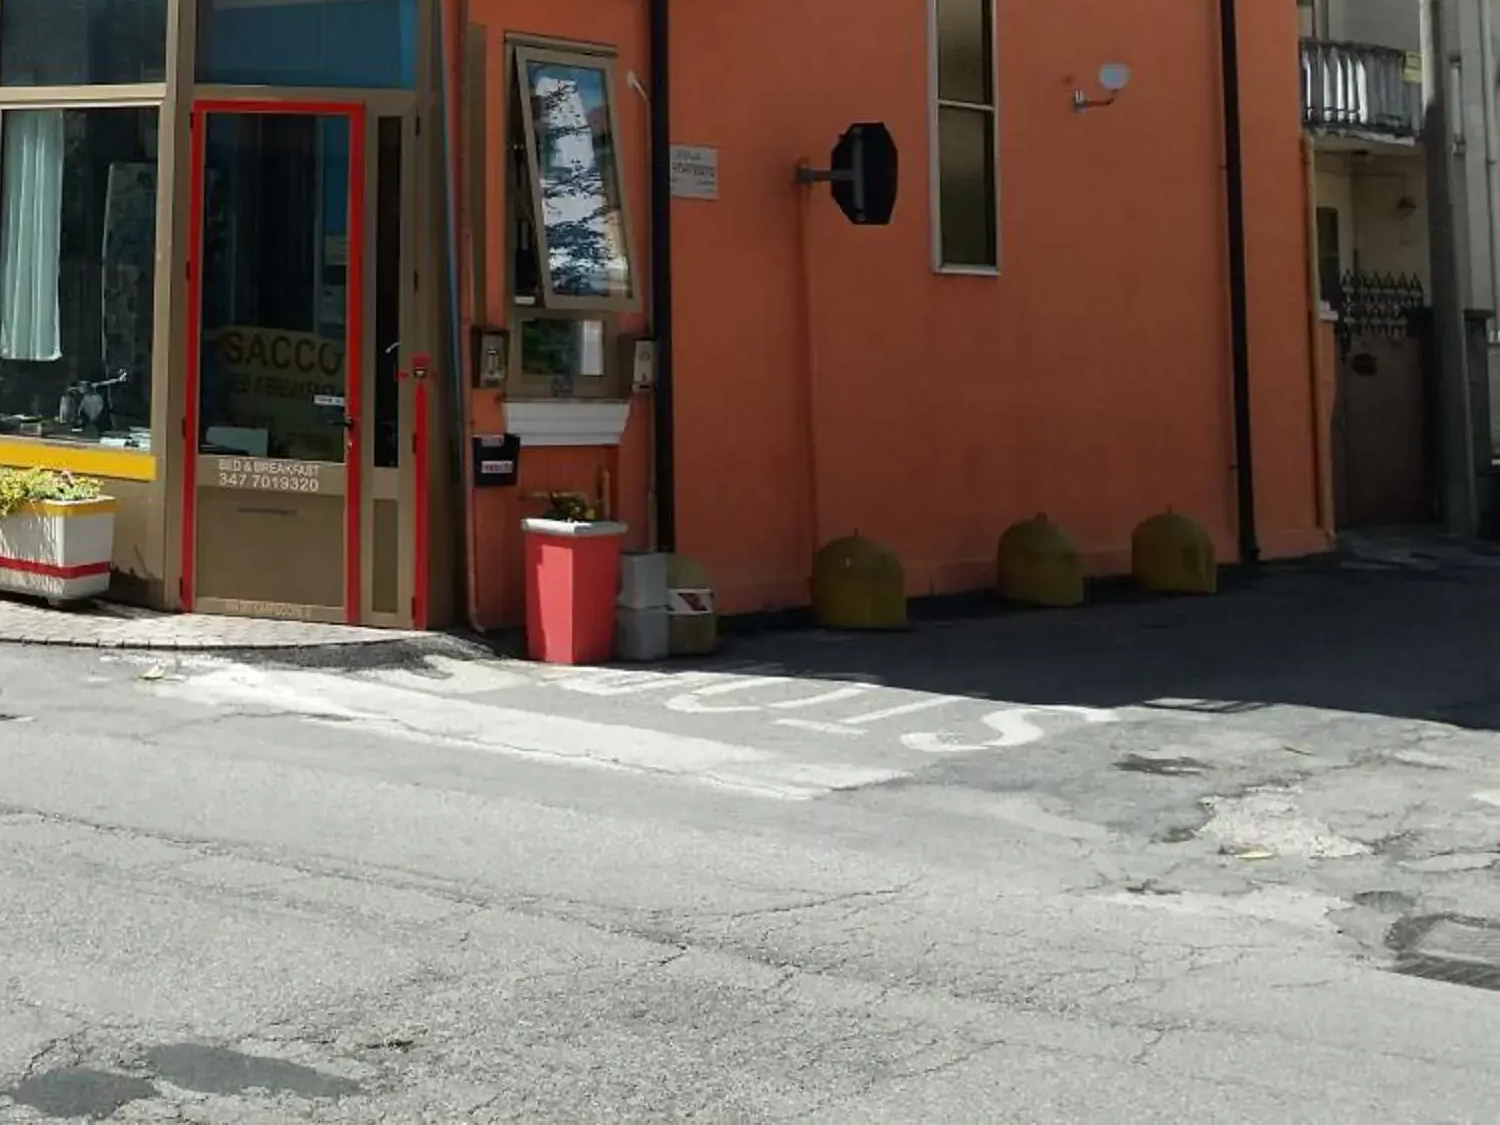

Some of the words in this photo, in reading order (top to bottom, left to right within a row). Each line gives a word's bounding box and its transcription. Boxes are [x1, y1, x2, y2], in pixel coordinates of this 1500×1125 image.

[223, 330, 341, 377] SACCO
[218, 458, 242, 472] BED
[253, 461, 320, 478] BREAKFAST
[218, 472, 247, 488] 347
